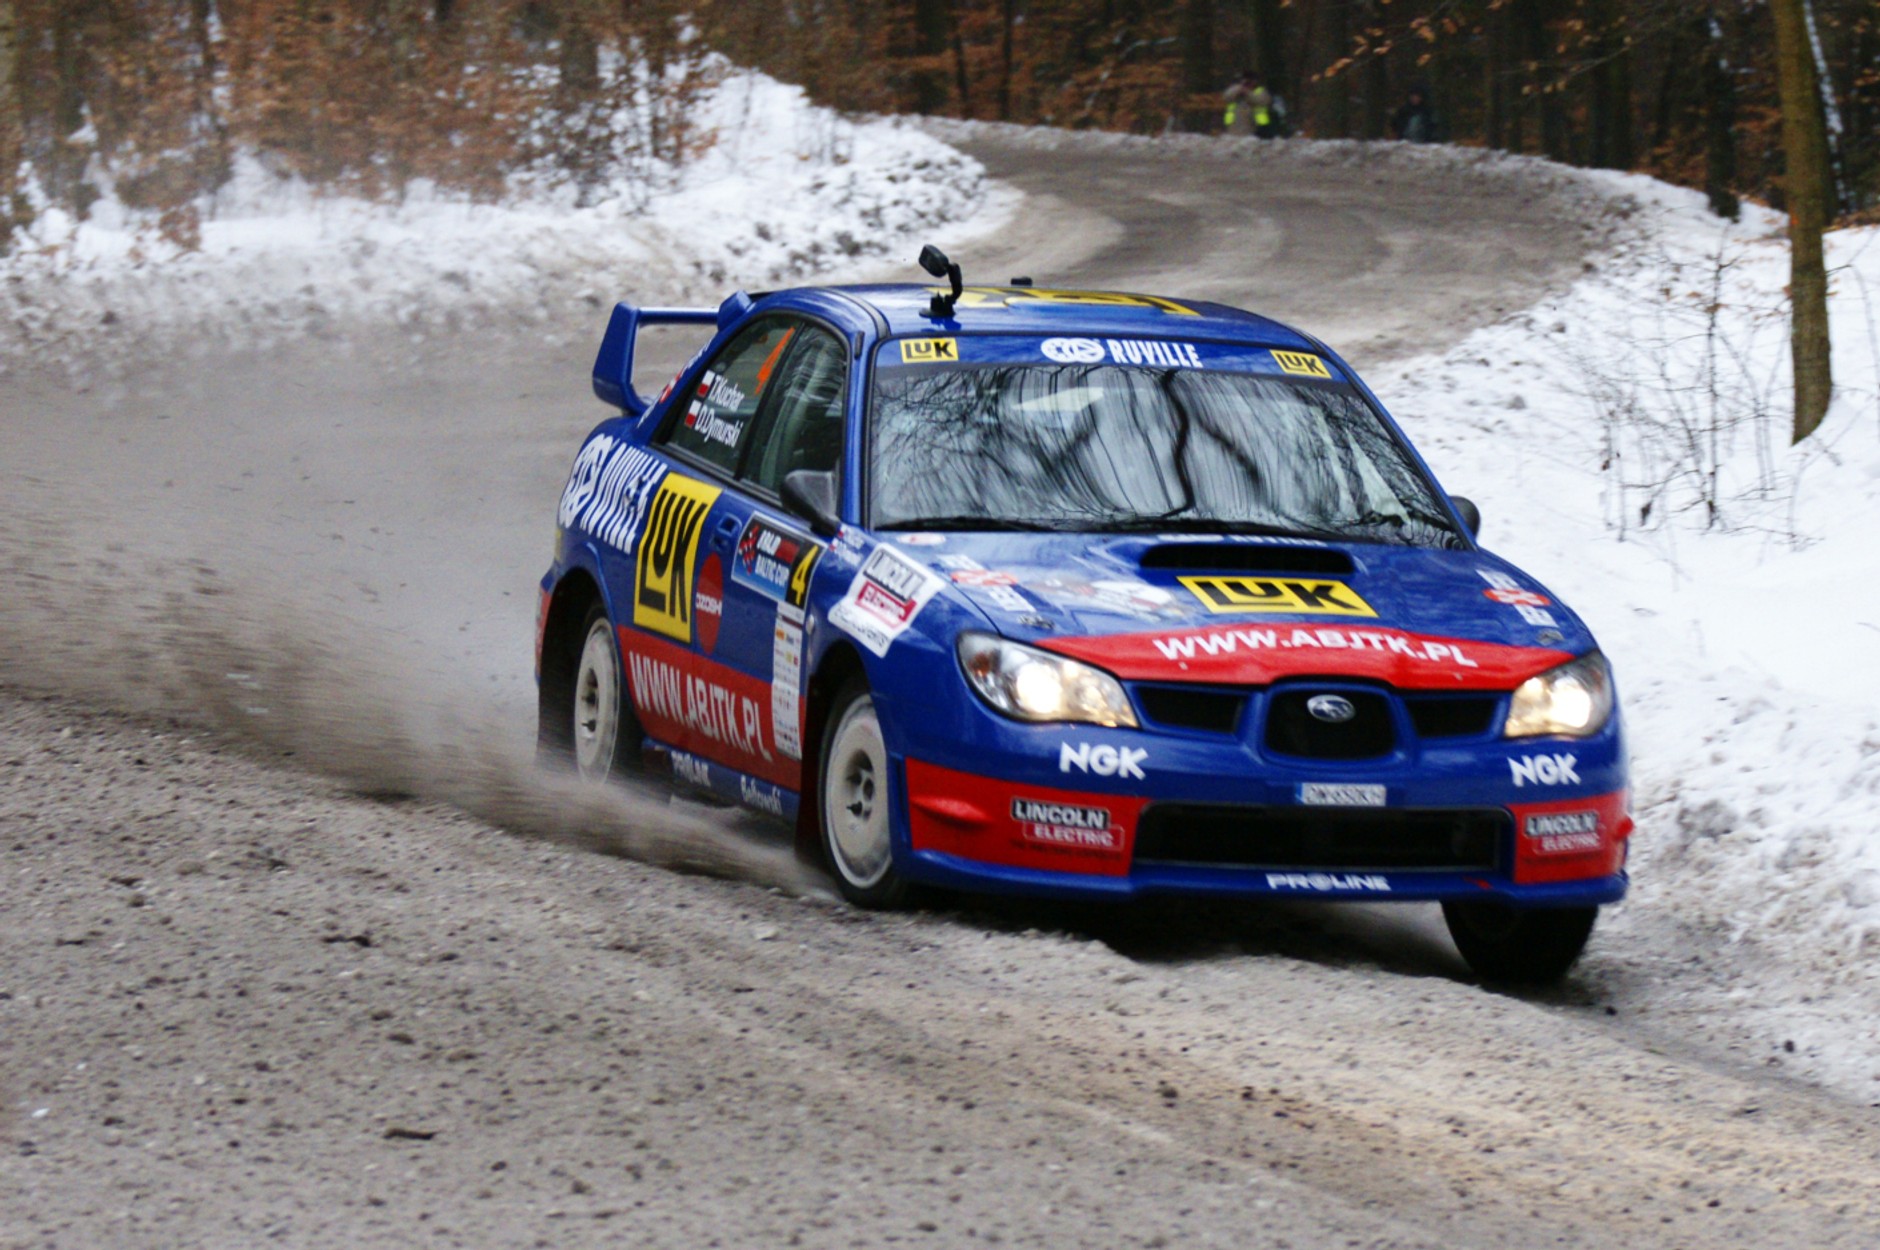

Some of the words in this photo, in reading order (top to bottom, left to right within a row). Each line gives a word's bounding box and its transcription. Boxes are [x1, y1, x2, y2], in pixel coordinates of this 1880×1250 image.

[1106, 339, 1203, 368] RUVILLE
[791, 544, 819, 606] 4
[1152, 629, 1478, 668] WWW.ABJTK.PL
[629, 650, 773, 762] WWW.ABJTK.PL
[1059, 741, 1148, 780] NGK
[1506, 753, 1581, 788] NGK
[1014, 799, 1105, 830] LINCOLN
[1034, 824, 1114, 847] ELECTRIC
[1265, 873, 1392, 891] PROLINE
